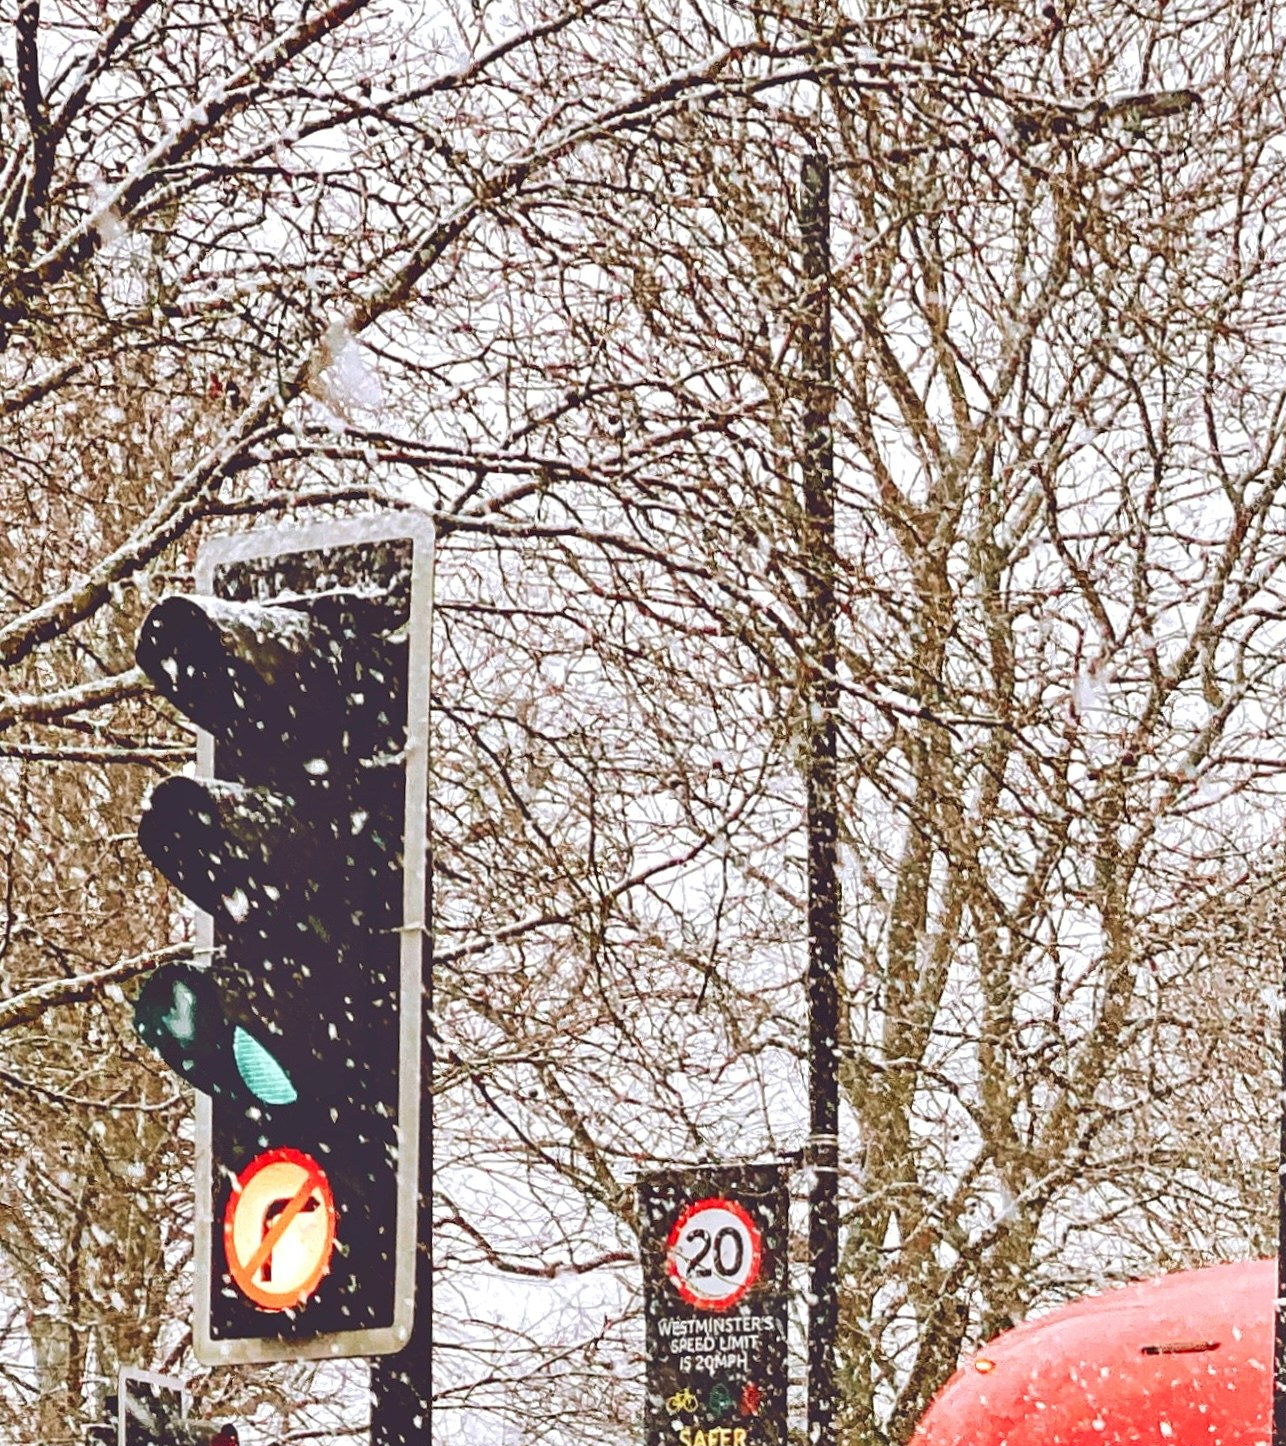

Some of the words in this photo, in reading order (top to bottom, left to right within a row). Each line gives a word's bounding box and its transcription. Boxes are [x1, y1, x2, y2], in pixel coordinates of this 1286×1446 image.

[686, 1226, 744, 1277] 20
[671, 1337, 715, 1354] SPEED
[720, 1335, 759, 1351] LIMIT
